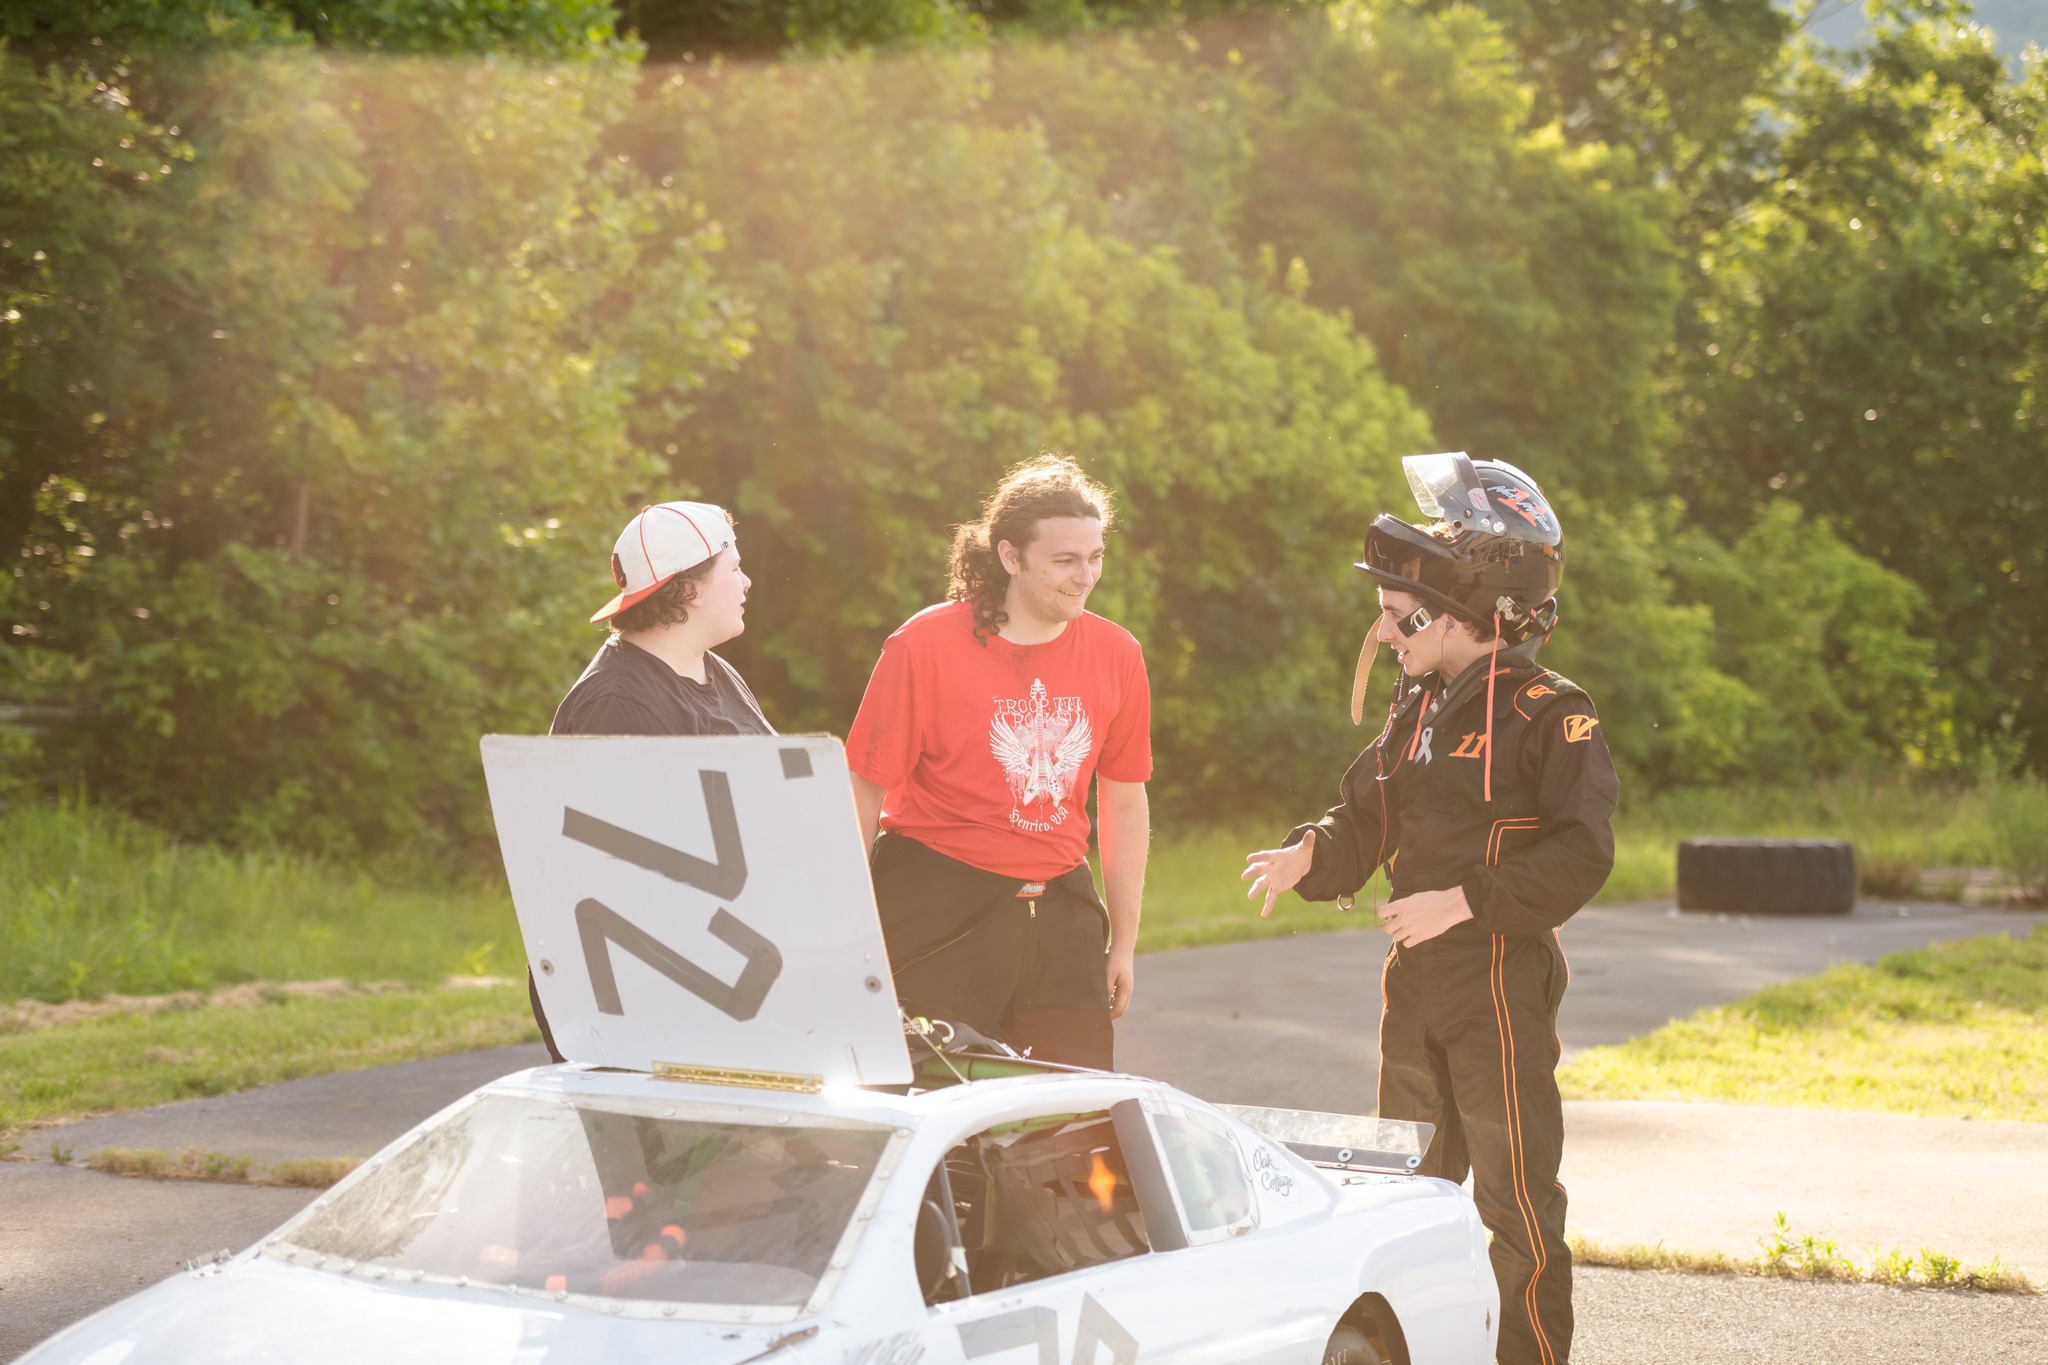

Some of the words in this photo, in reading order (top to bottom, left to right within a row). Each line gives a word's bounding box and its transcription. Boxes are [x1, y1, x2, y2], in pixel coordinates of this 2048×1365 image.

[993, 699, 1049, 714] TROOP
[1053, 697, 1081, 712] 777
[1448, 731, 1488, 758] 11
[1009, 809, 1053, 832] Henrico,
[1050, 804, 1068, 825] VA
[1253, 1149, 1280, 1172] Oak
[1261, 1171, 1293, 1196] Cottage
